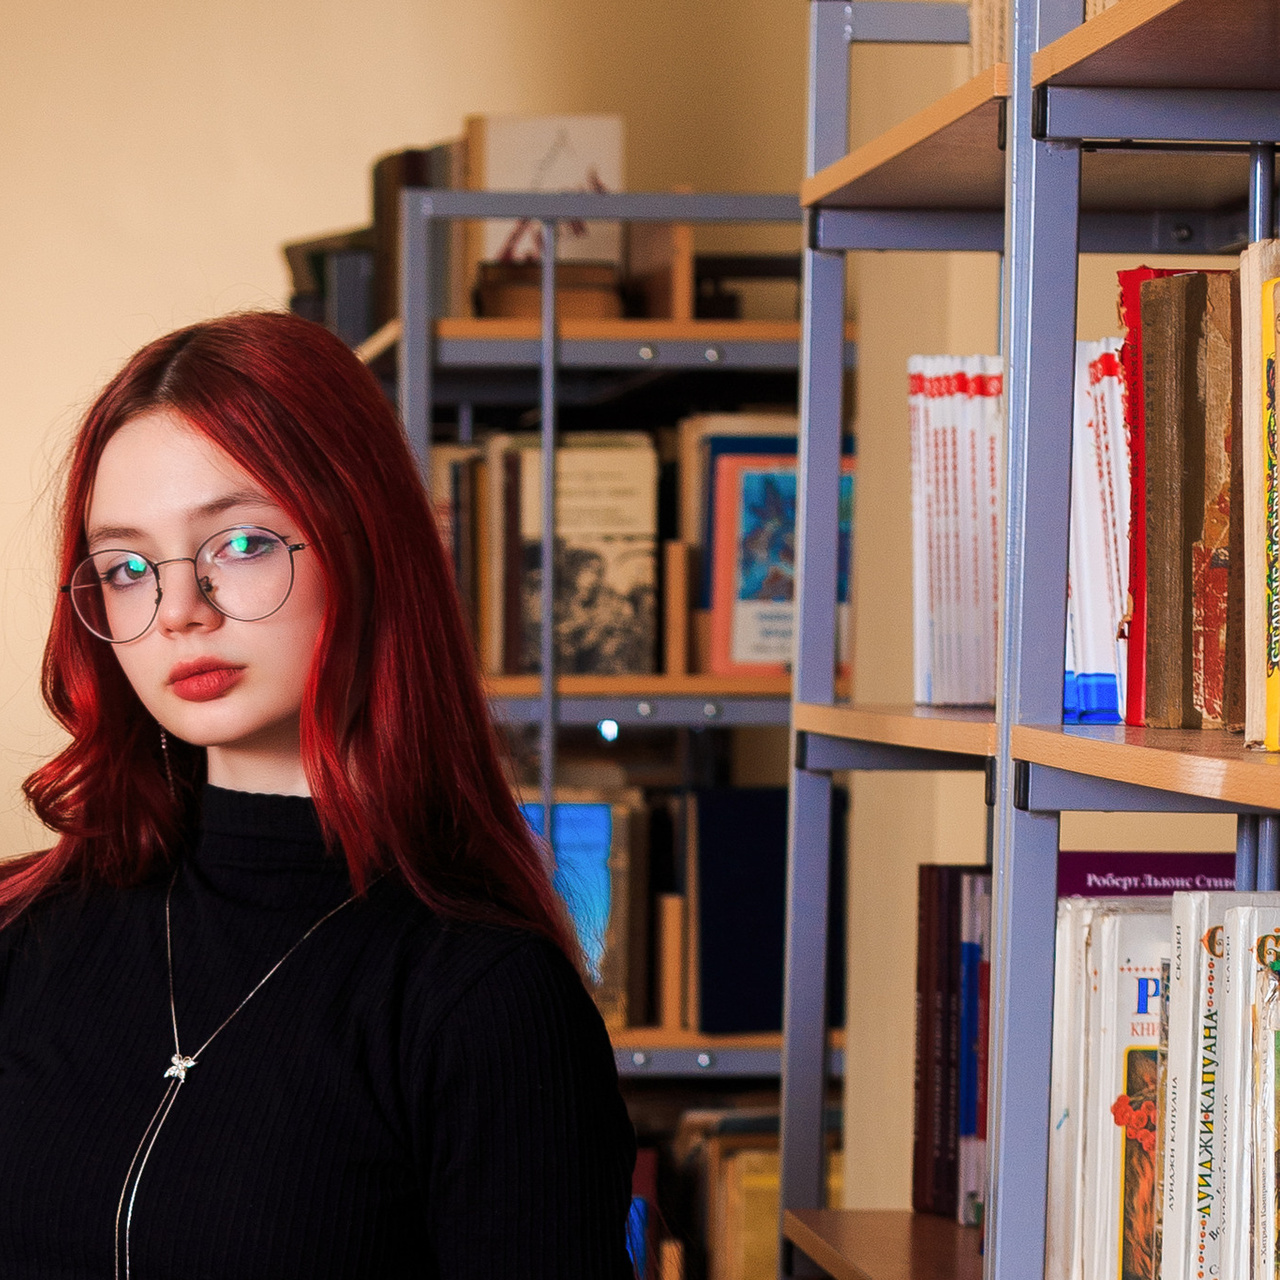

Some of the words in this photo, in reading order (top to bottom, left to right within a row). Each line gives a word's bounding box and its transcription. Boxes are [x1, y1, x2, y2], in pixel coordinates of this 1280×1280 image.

[1086, 873, 1140, 892] Роберт
[1200, 1009, 1219, 1114] КАПУАНА
[1169, 1076, 1178, 1143] КАПУАНА
[1168, 1147, 1176, 1211] ЛУИДЖИ
[1197, 1120, 1215, 1217] ЛУИДЖИ
